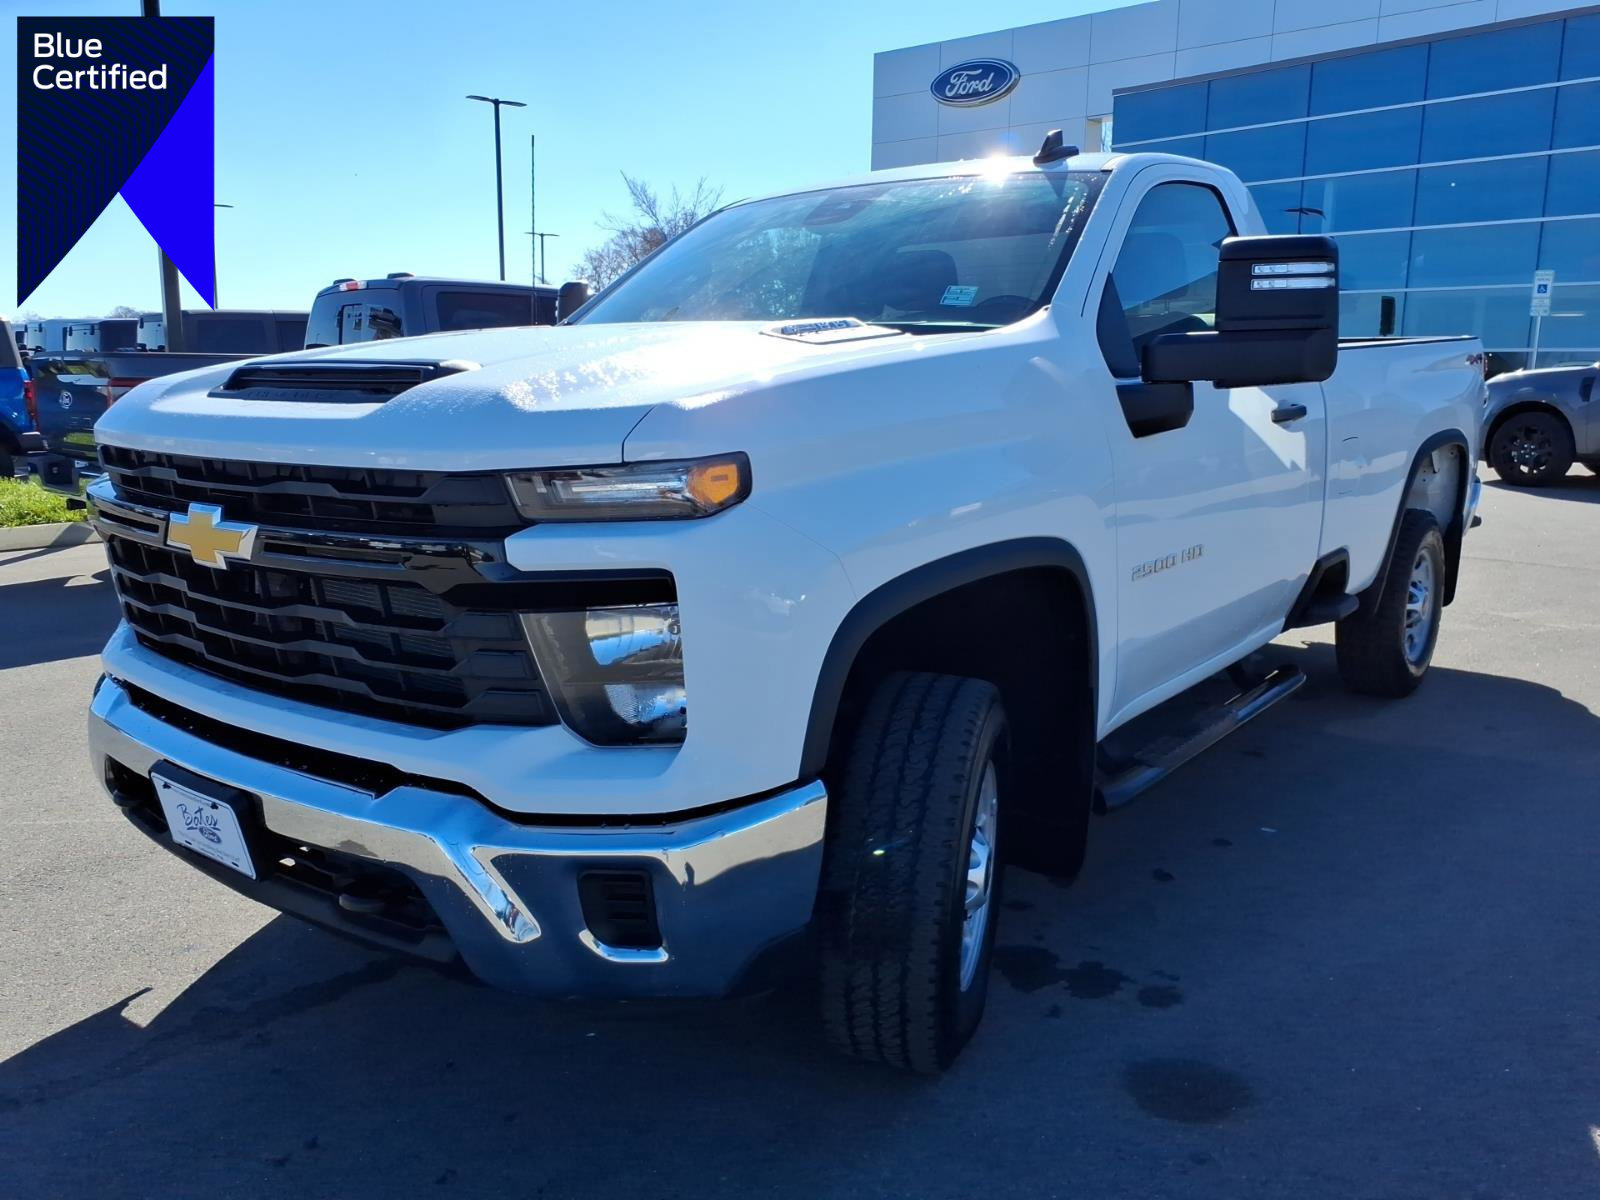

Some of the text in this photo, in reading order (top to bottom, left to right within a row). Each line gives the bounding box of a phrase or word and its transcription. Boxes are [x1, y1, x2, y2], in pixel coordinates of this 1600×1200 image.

[945, 69, 995, 97] Ford
[1131, 543, 1204, 582] 2500 HD
